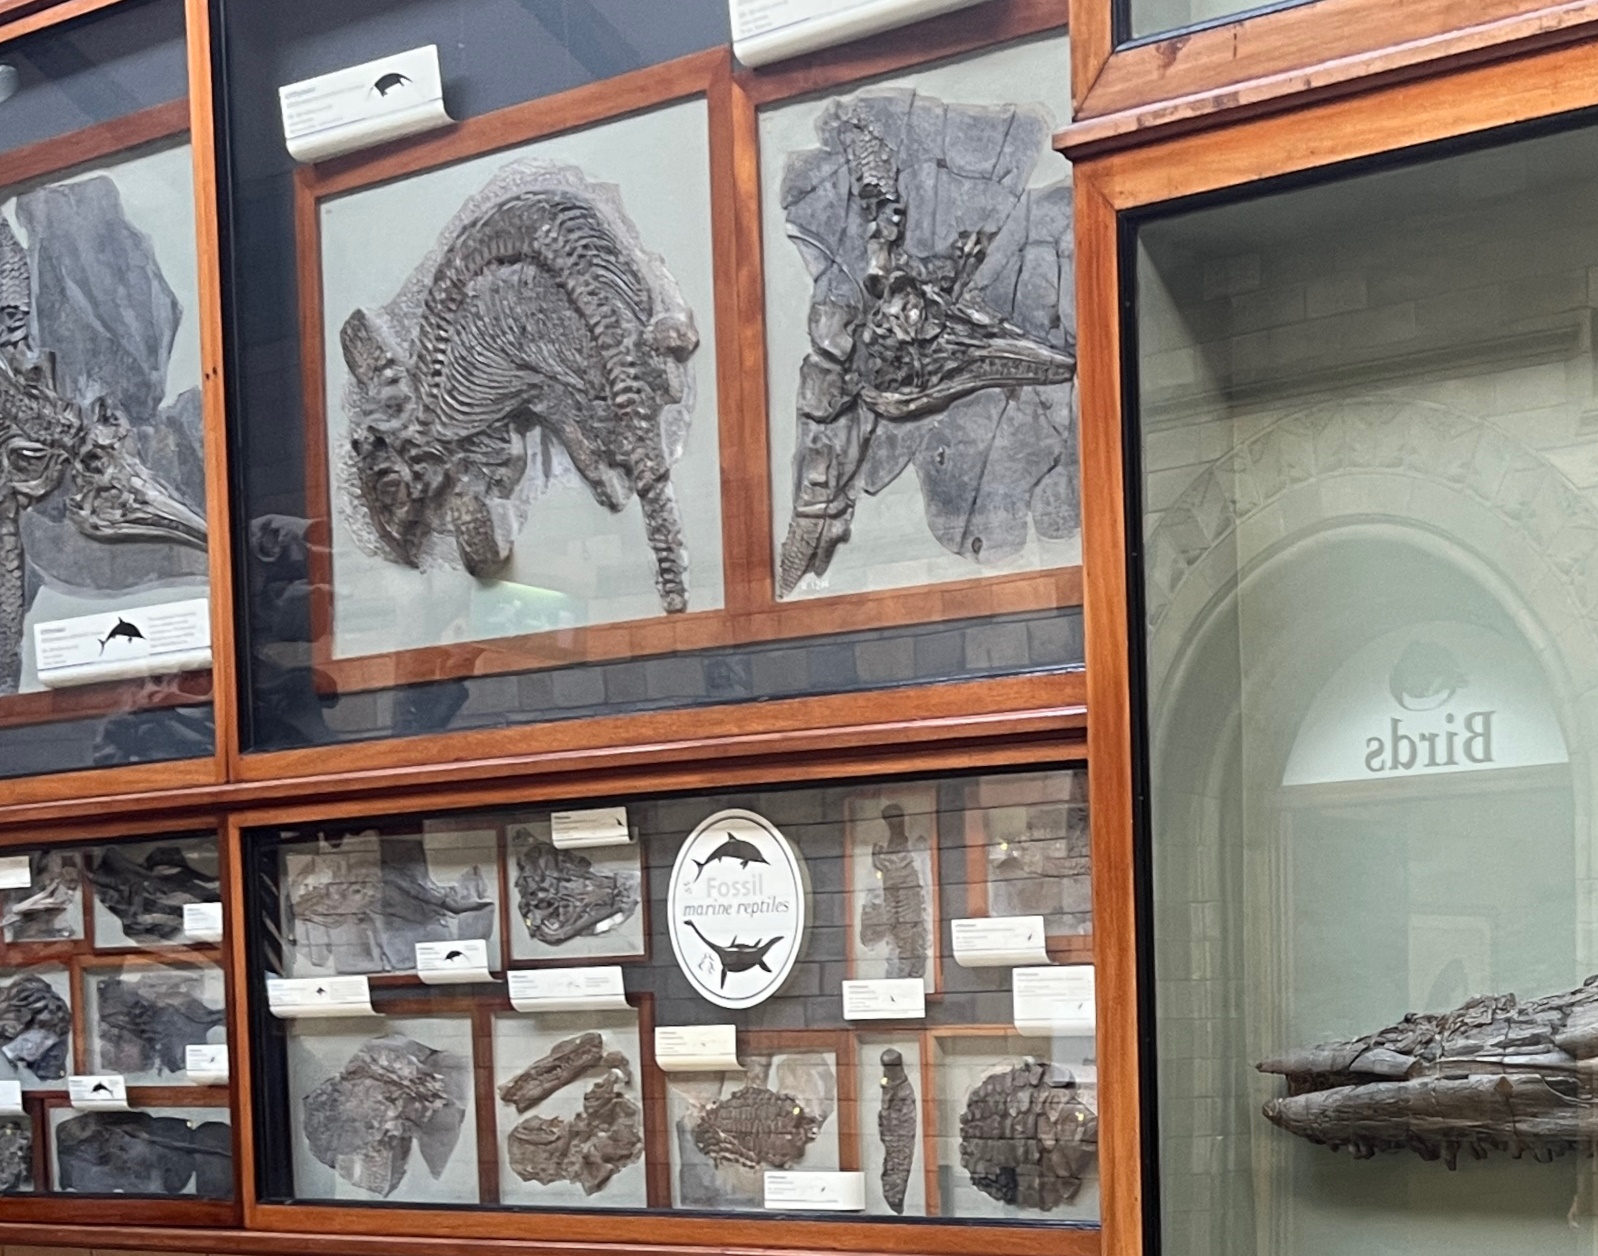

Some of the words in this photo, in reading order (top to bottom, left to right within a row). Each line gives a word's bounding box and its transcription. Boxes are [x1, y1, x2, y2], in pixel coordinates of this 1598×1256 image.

[706, 873, 763, 898] Fossil
[683, 898, 733, 917] marine
[736, 895, 790, 918] reptiles
